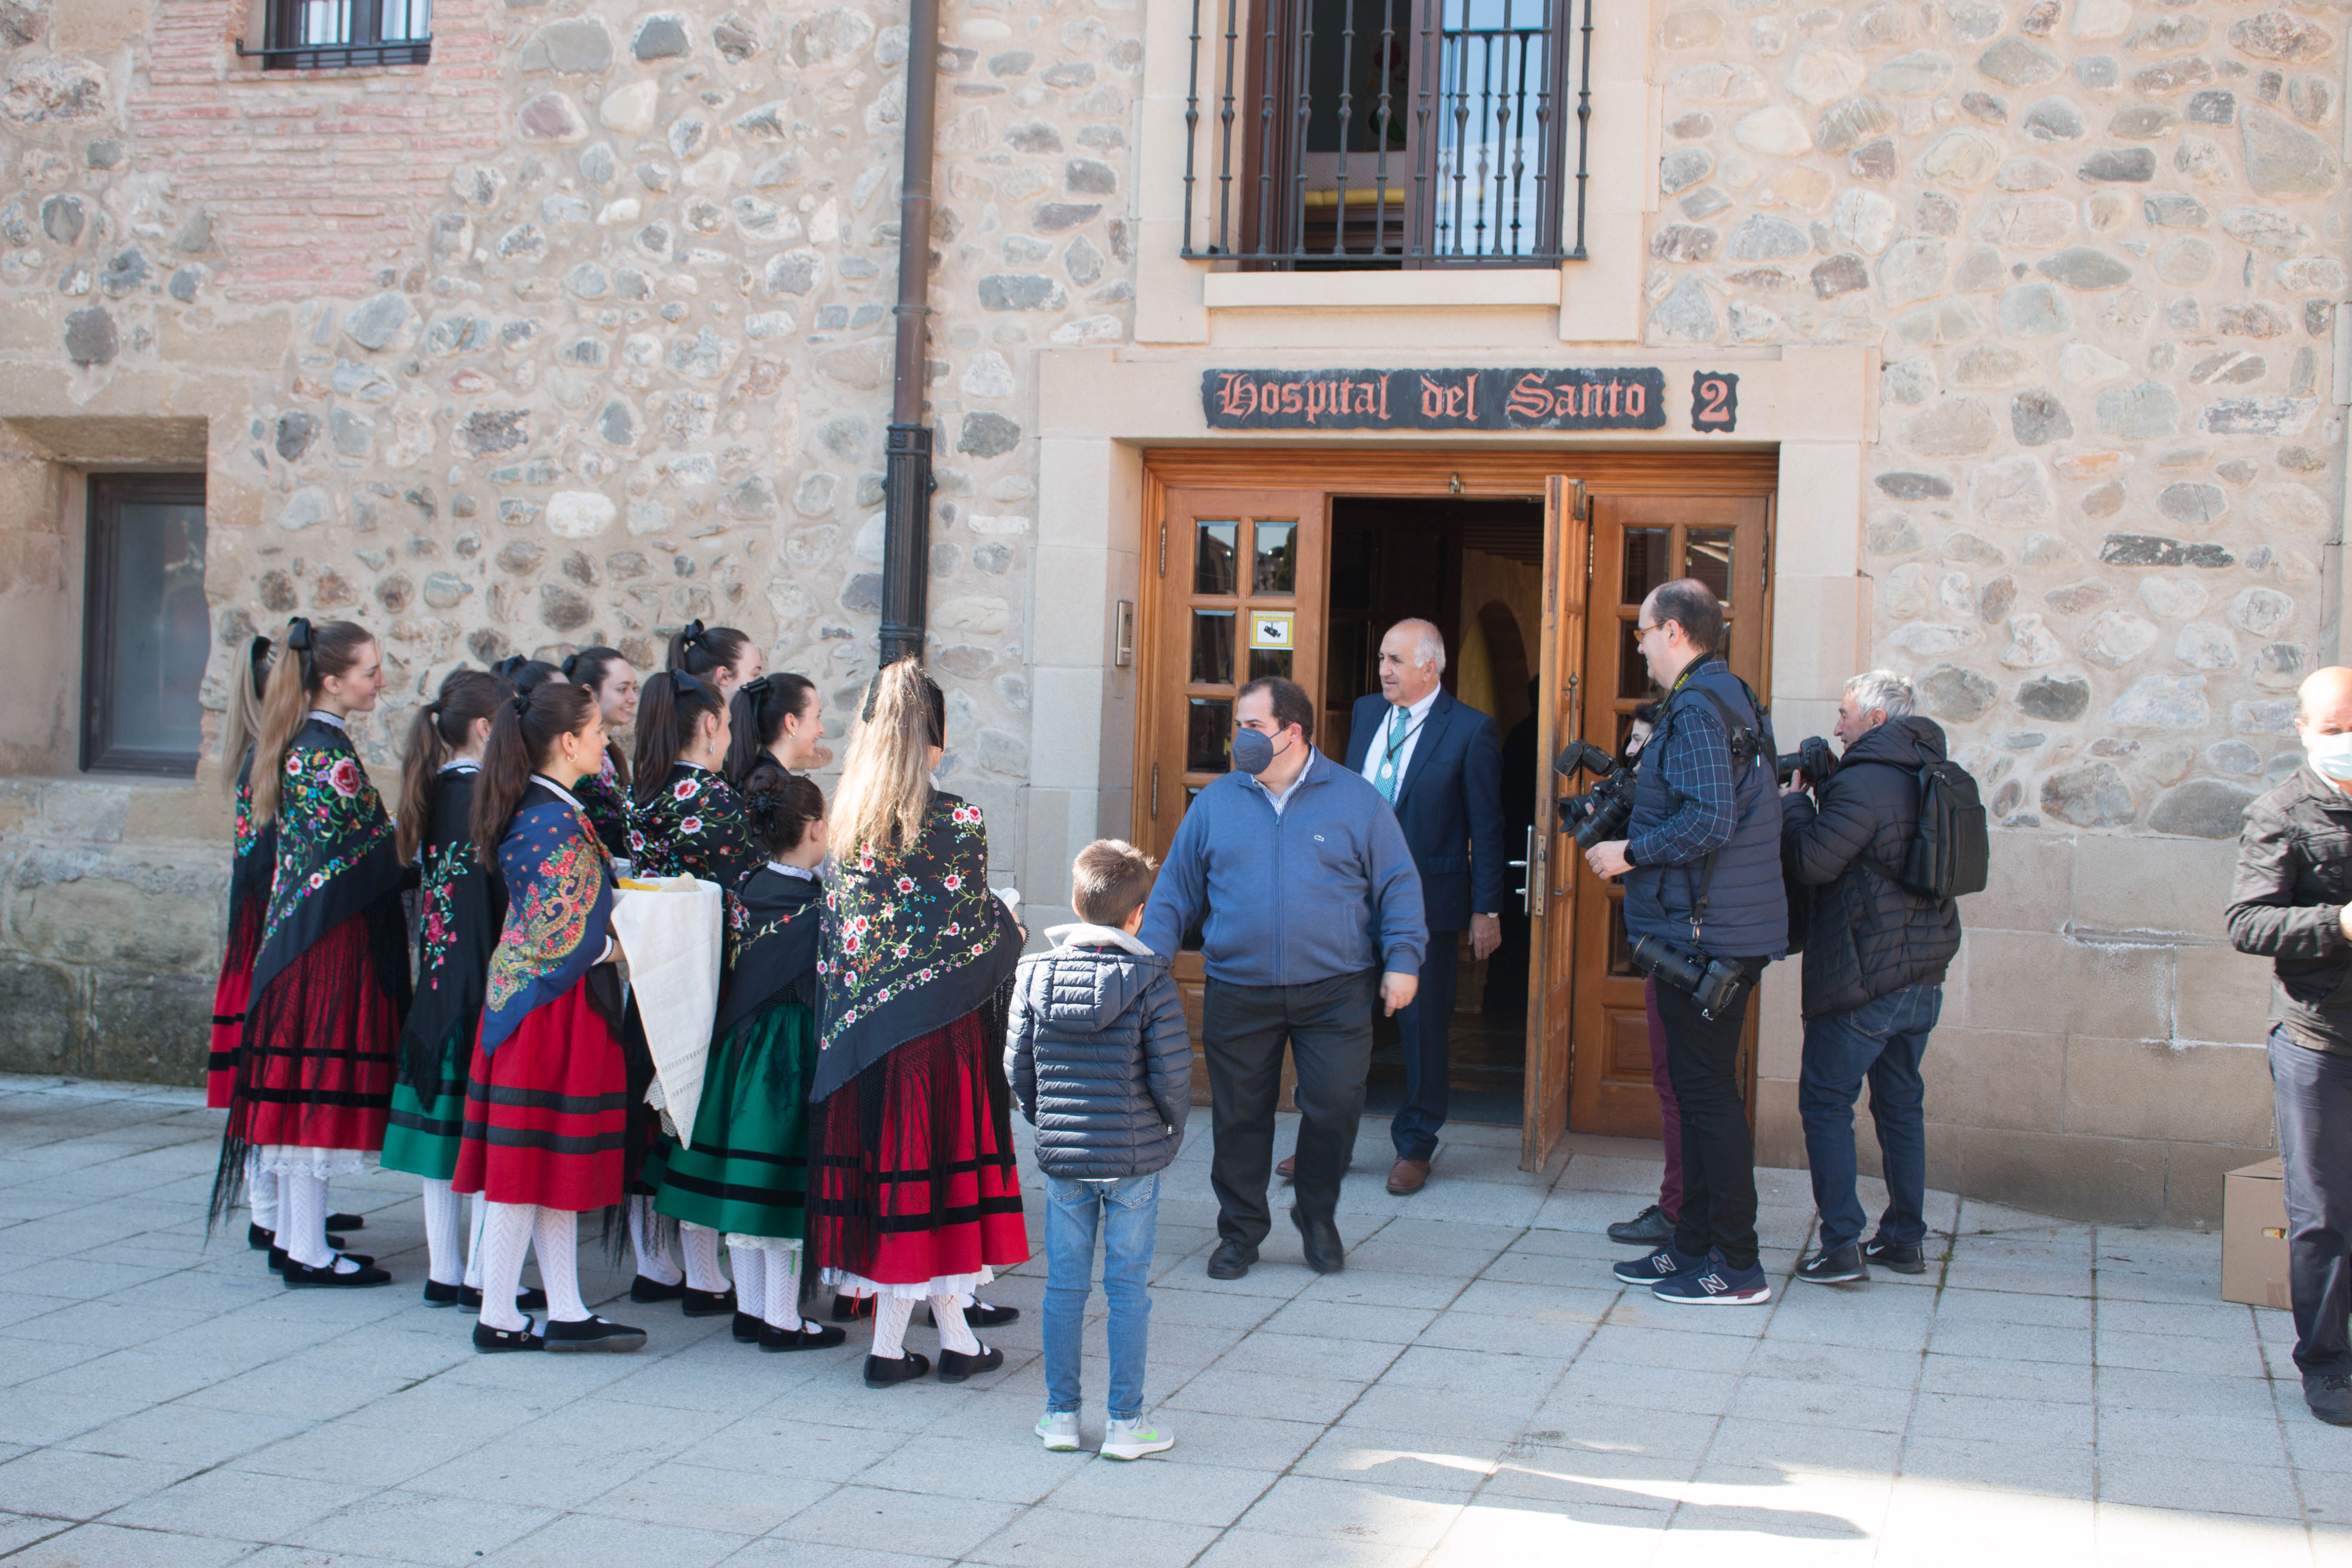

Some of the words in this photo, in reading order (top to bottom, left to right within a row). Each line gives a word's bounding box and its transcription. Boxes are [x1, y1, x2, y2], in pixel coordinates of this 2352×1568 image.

[1216, 373, 1392, 424] Hospital
[1420, 373, 1479, 422] del
[1507, 372, 1646, 418] Santo
[1699, 379, 1730, 422] 2
[1674, 673, 1688, 691] Nikon
[1652, 1253, 1676, 1274] N
[1698, 1273, 1728, 1295] N
